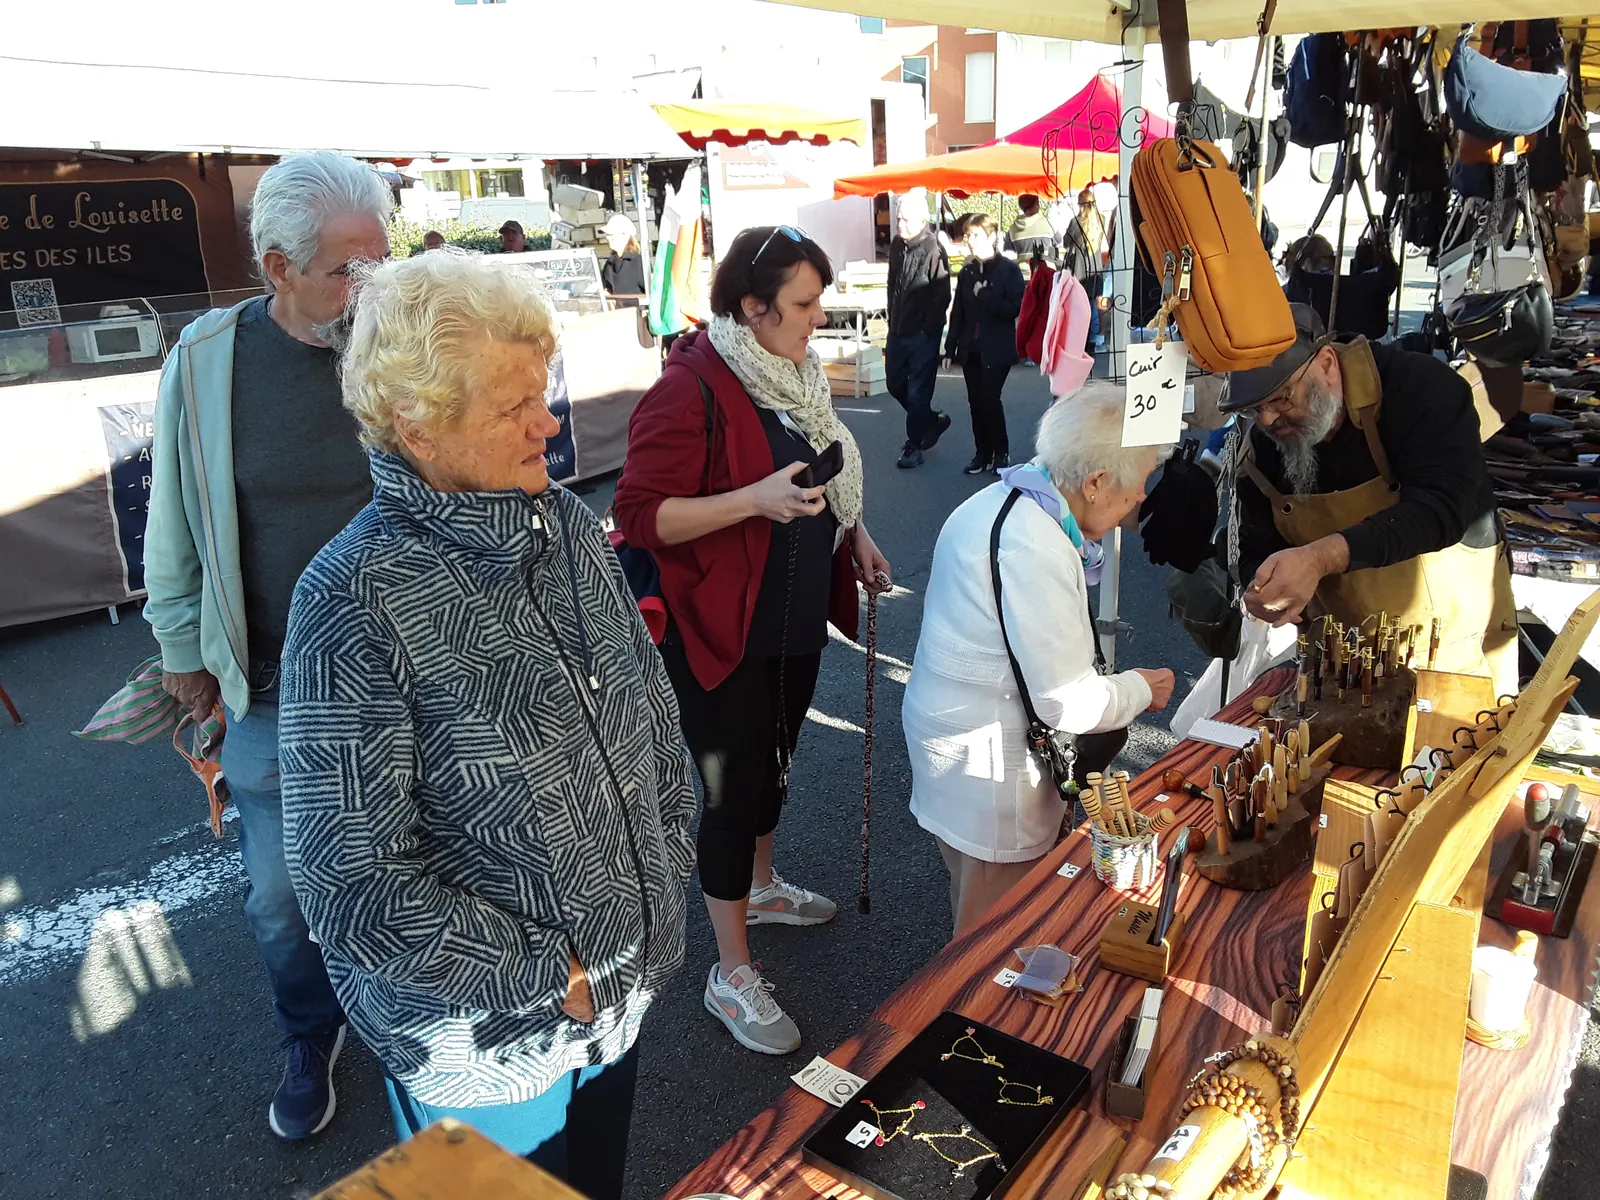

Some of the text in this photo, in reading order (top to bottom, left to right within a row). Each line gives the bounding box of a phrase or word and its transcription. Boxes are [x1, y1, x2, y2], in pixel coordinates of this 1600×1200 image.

[25, 194, 54, 230] de
[68, 191, 184, 234] Louisette
[35, 248, 77, 268] DES
[87, 244, 132, 265] ILES
[1128, 355, 1163, 377] Cuir
[1129, 394, 1157, 419] 30
